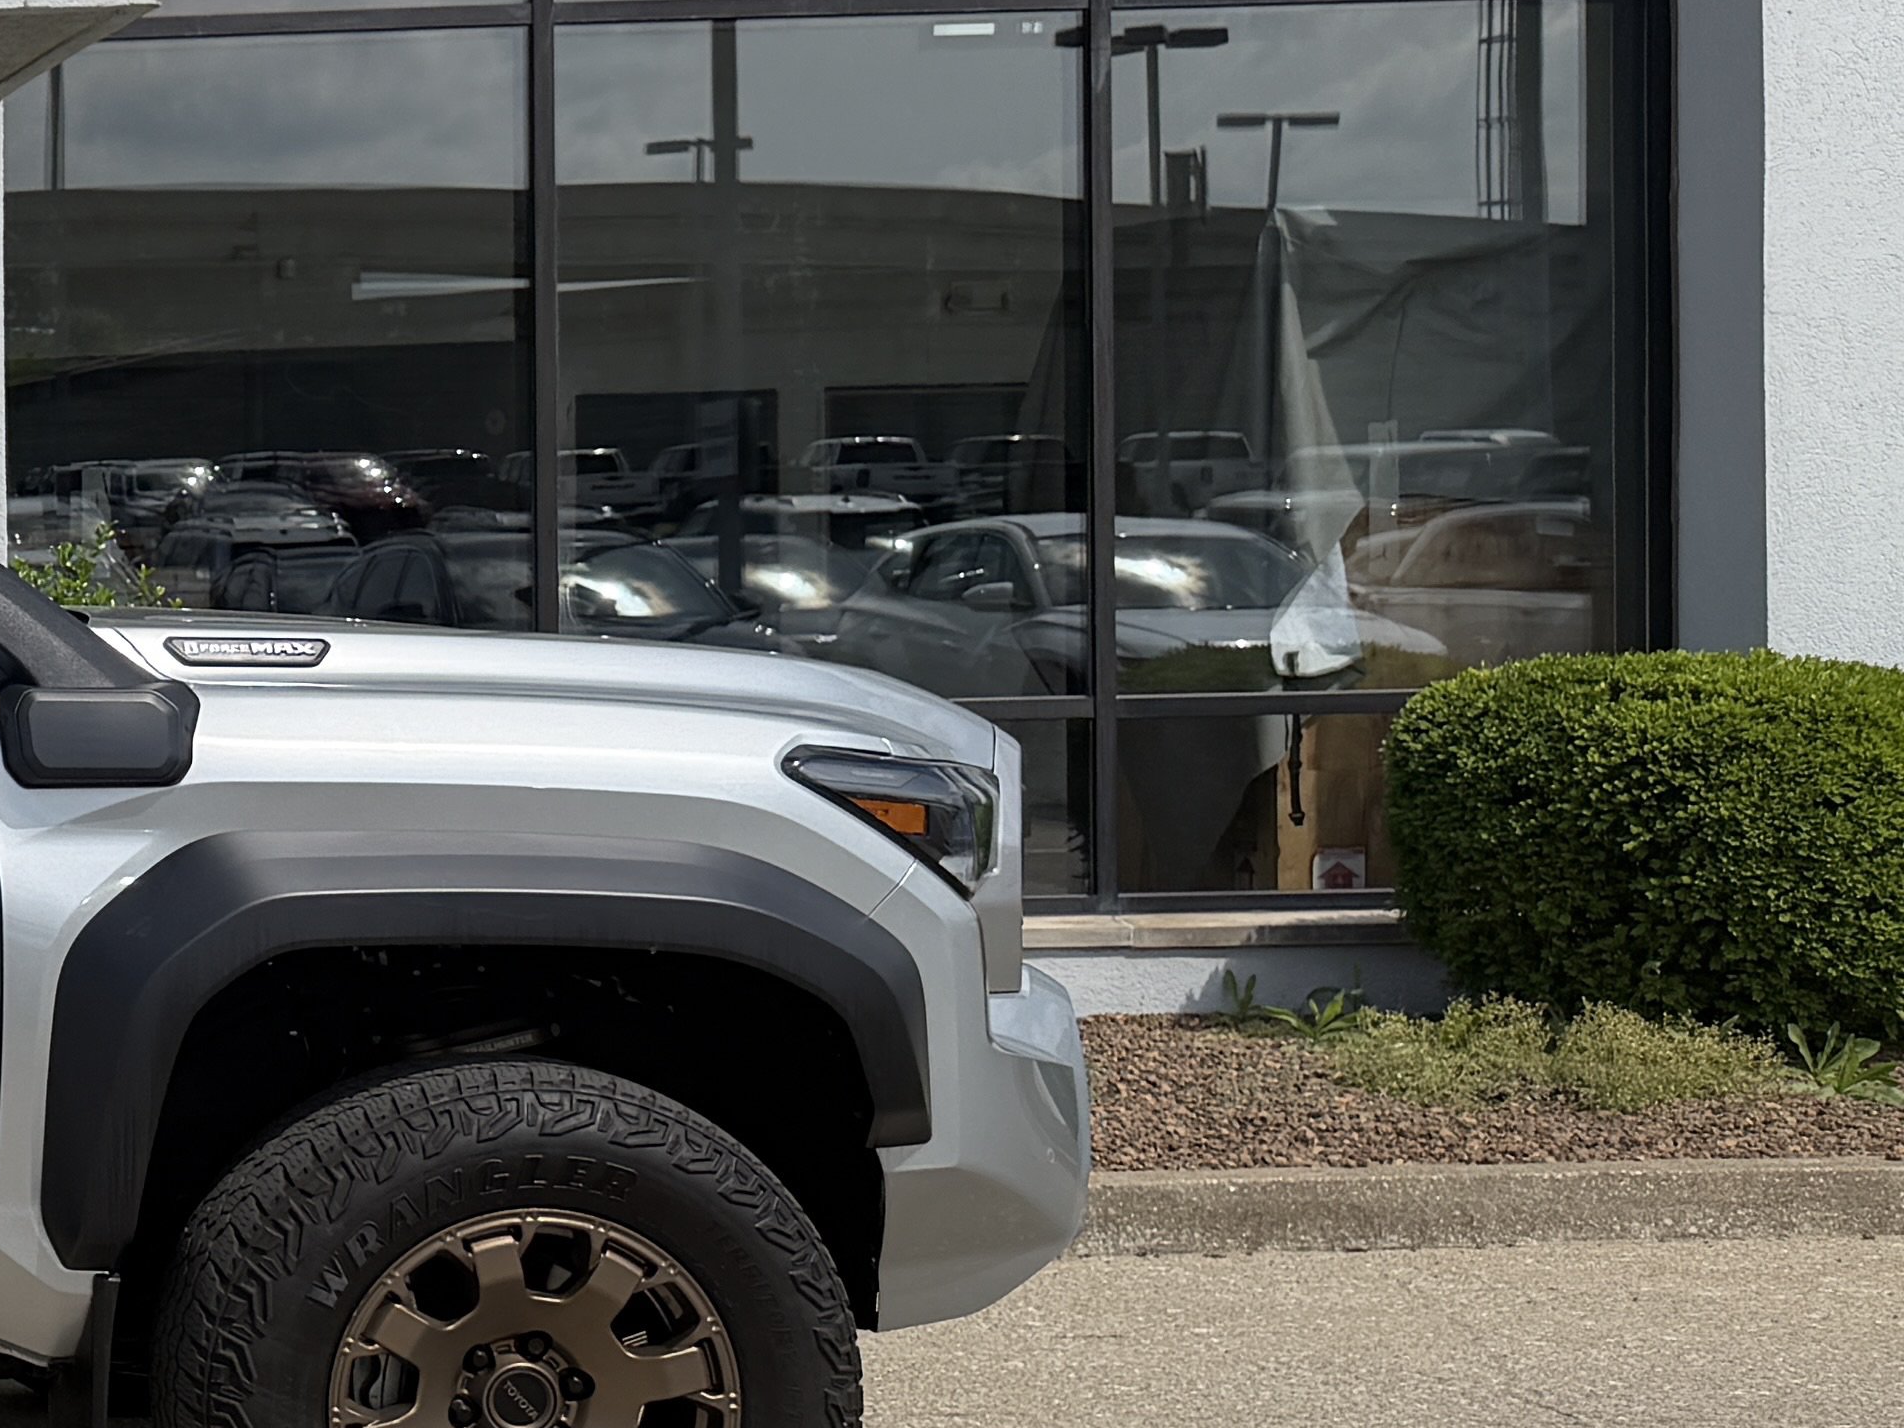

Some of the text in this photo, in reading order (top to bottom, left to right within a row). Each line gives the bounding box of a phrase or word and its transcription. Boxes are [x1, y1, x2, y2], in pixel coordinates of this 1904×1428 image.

[250, 642, 316, 655] MAX
[304, 1152, 640, 1312] WRANGLER
[503, 1379, 538, 1420] TOYOTA
